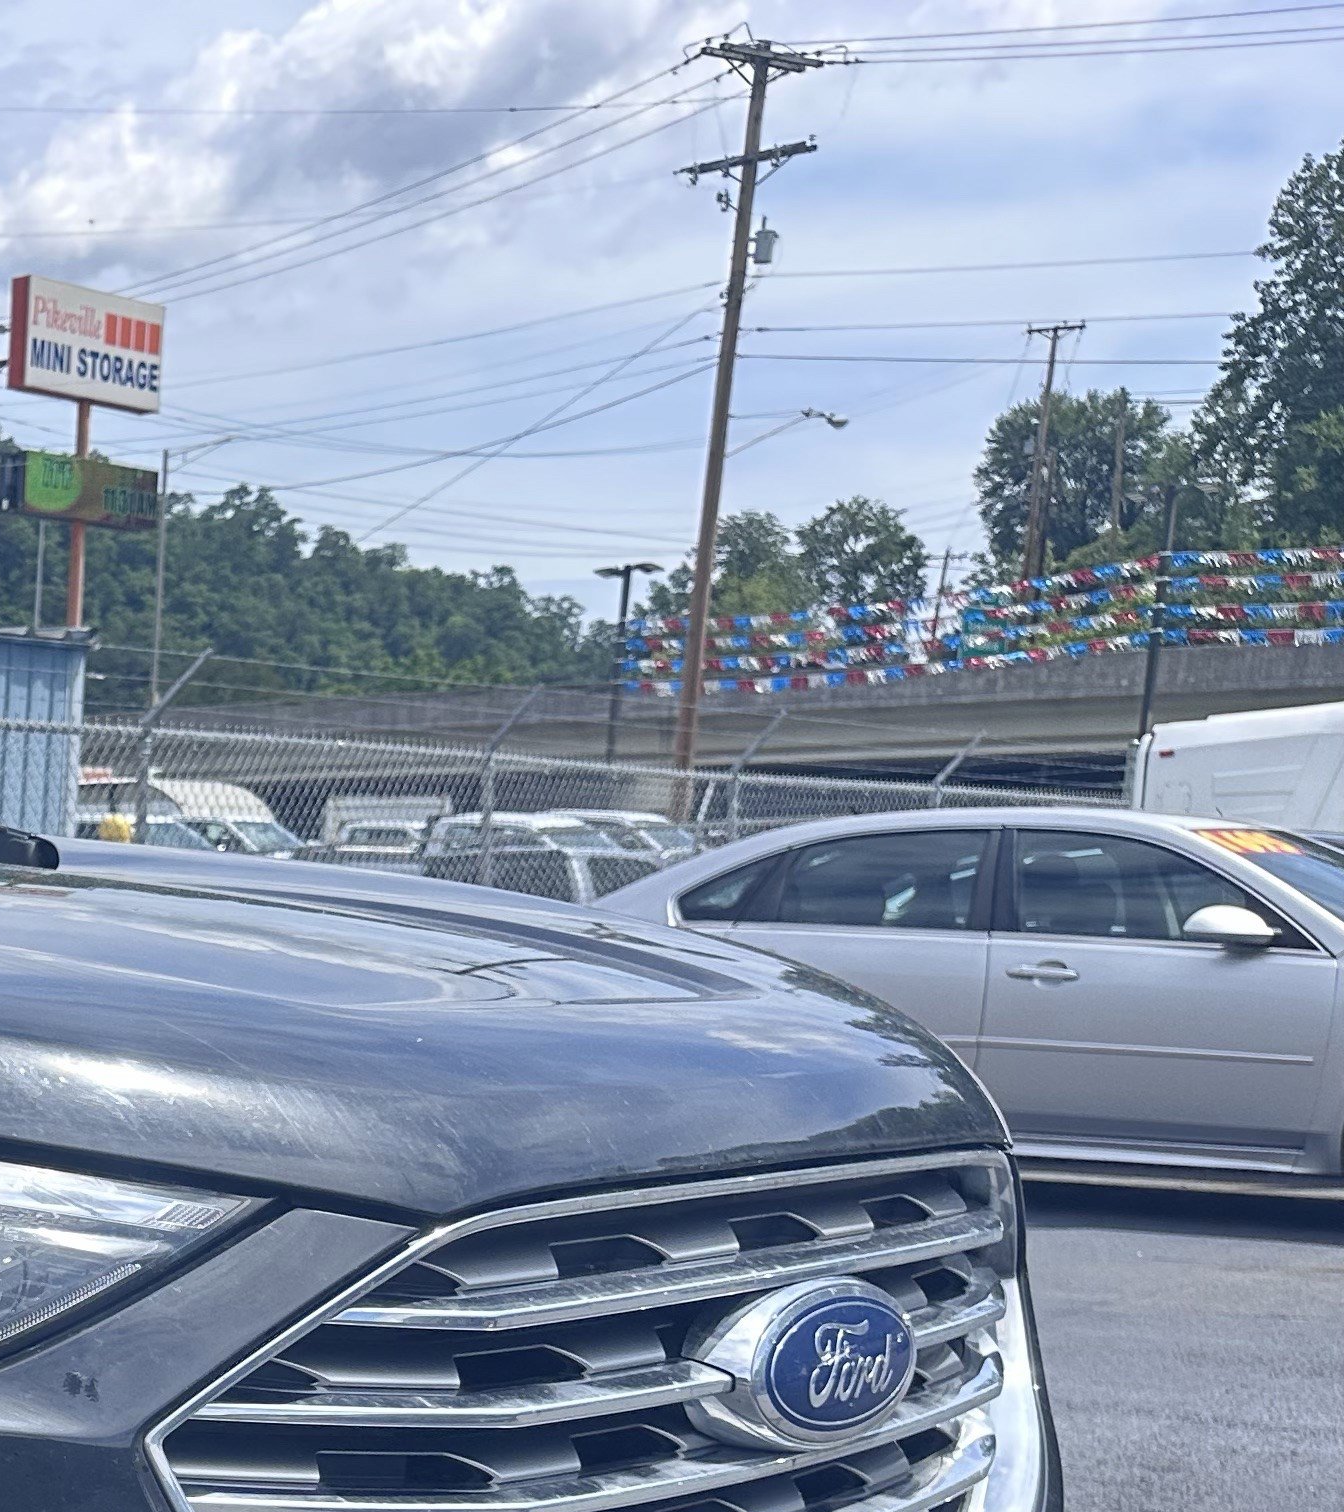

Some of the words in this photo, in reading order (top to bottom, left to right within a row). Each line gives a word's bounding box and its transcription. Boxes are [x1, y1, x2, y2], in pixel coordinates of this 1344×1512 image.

[30, 337, 72, 375] MINI
[77, 347, 159, 393] STORAGE
[810, 1320, 894, 1410] Ford
